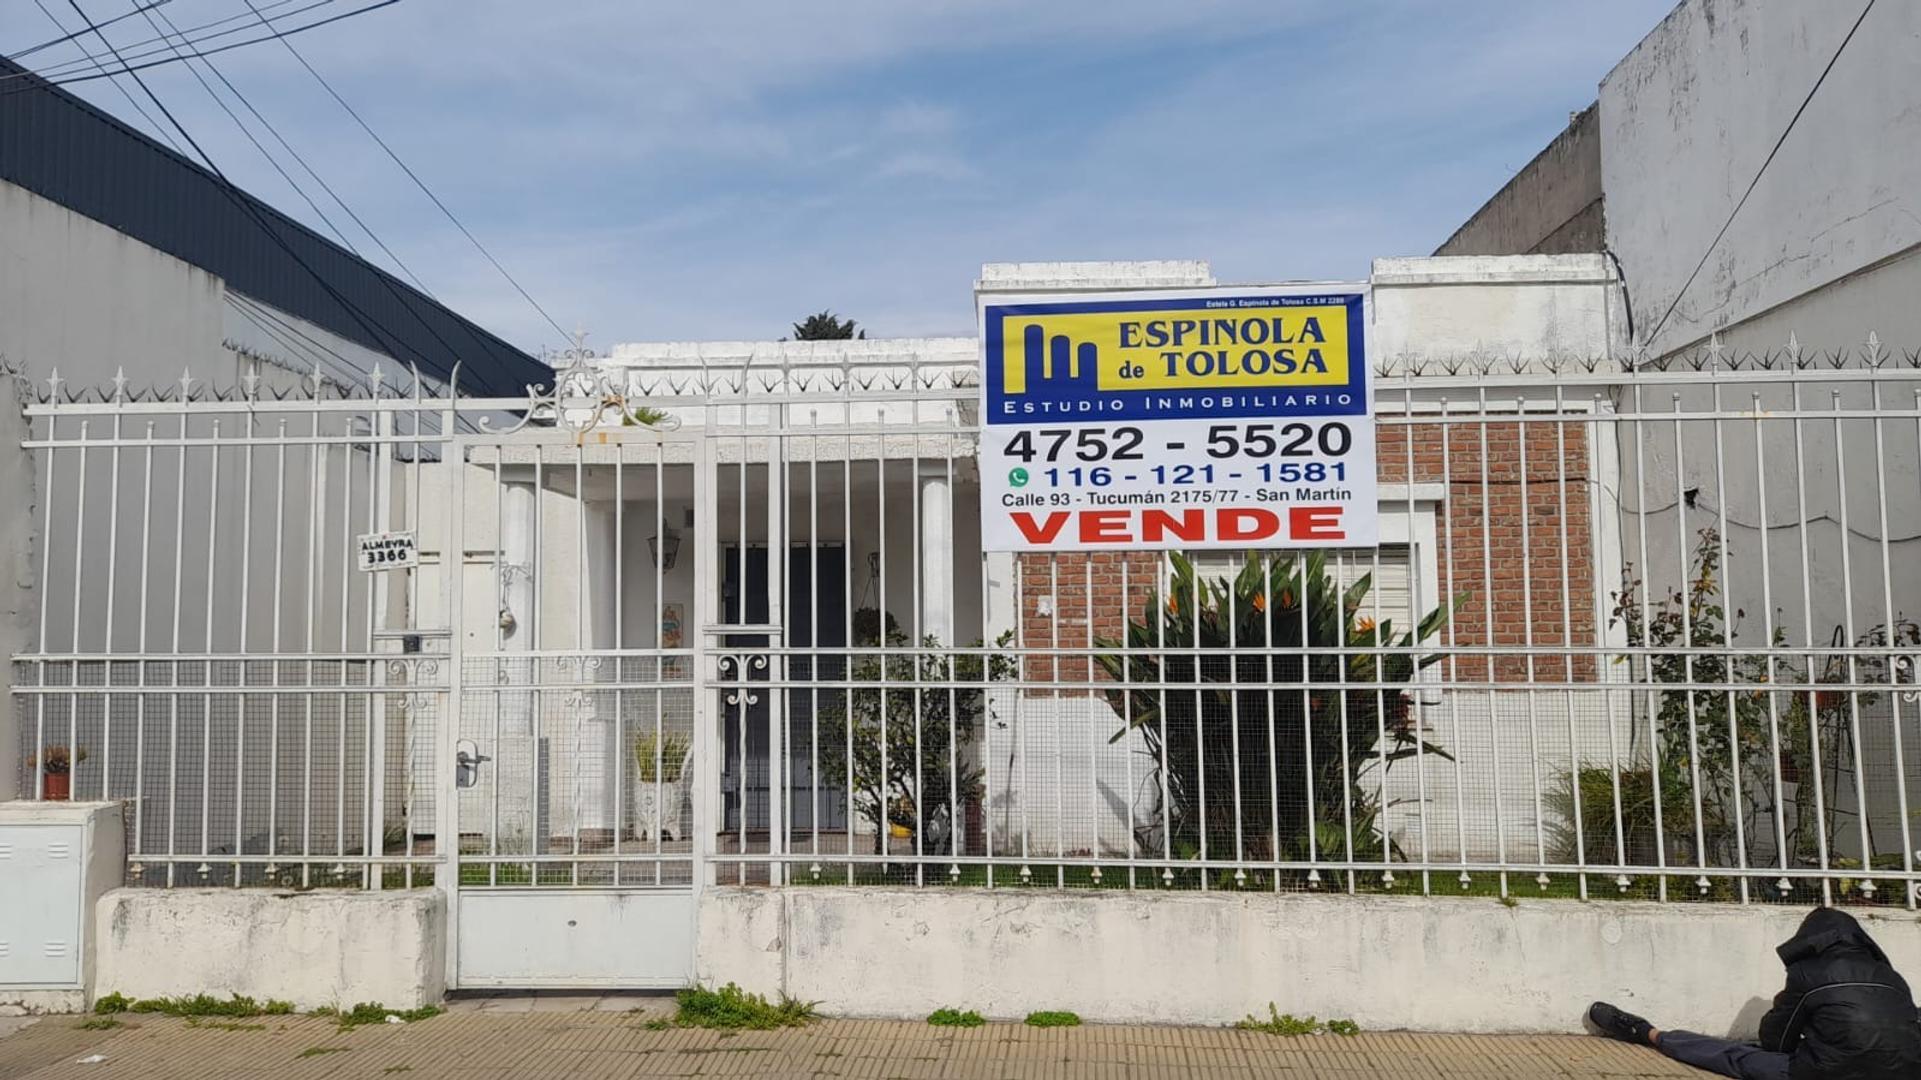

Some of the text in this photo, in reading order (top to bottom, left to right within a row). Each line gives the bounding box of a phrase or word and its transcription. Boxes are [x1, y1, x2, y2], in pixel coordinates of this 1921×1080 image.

[1119, 316, 1326, 348] ESPINOLA
[1118, 348, 1328, 379] de TOLOSA
[1003, 426, 1144, 463] 4752
[1206, 422, 1352, 459] 5520
[1044, 466, 1112, 487] 116
[1150, 464, 1214, 484] 121
[1256, 462, 1345, 482] 1581
[1002, 493, 1045, 507] Calle
[1050, 493, 1070, 506] 93
[1087, 490, 1165, 505] Tucumán
[1170, 490, 1238, 504] 2175/77
[1256, 488, 1289, 501] San
[1296, 487, 1352, 501] Martín
[1009, 506, 1345, 545] VENDE
[367, 549, 407, 564] 3366
